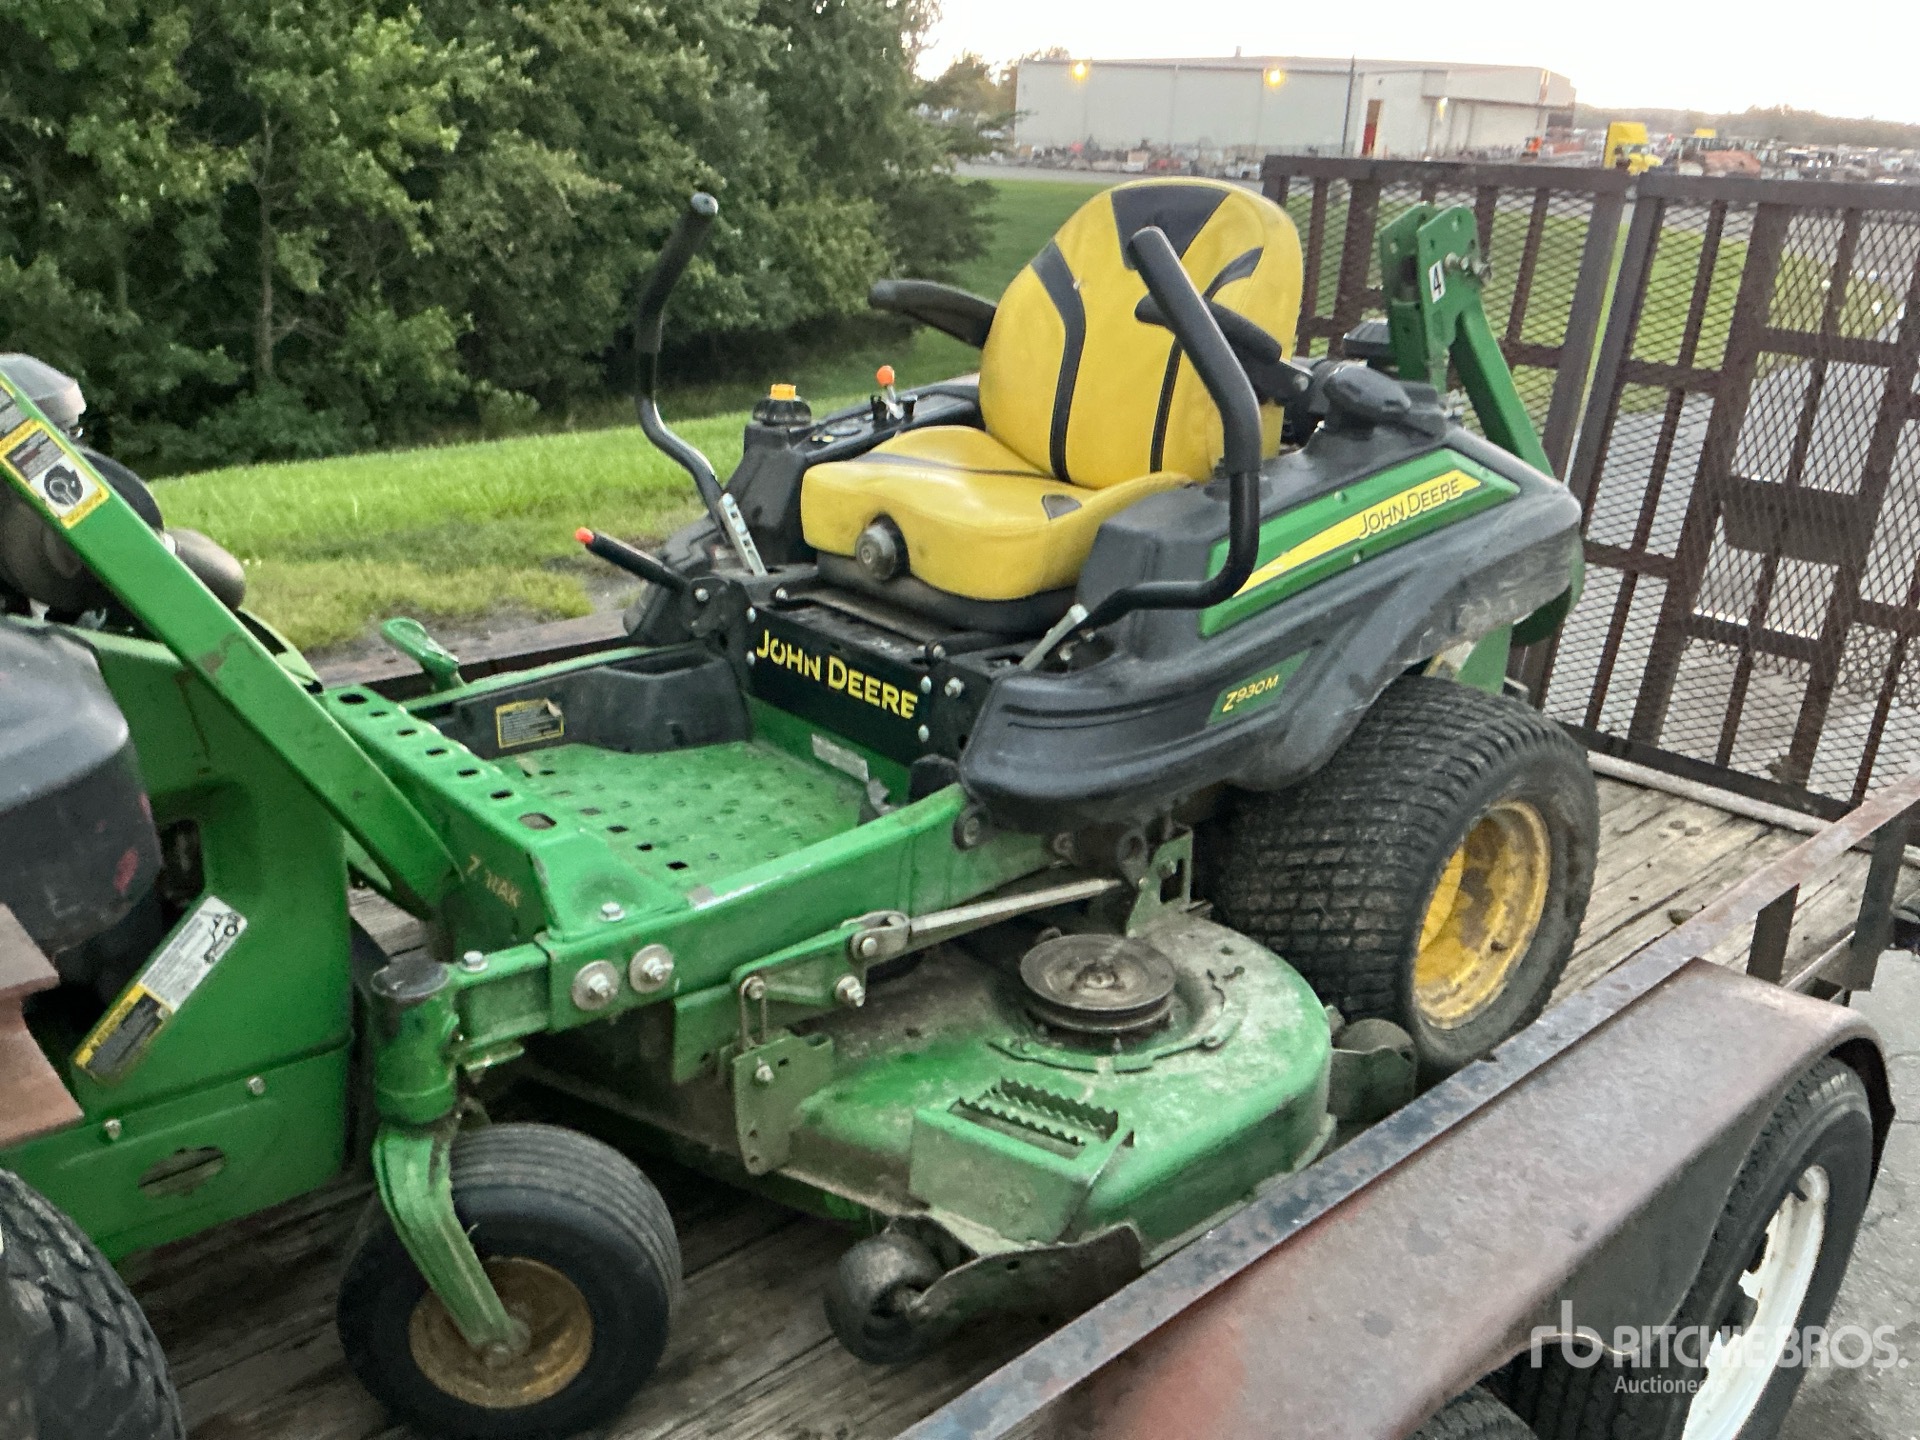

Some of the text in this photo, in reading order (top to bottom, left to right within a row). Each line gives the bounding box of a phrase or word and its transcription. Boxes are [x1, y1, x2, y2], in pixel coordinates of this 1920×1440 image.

[1433, 265, 1442, 296] 4
[1359, 478, 1461, 537] JOHN DEERE
[756, 628, 919, 720] JOHN DEERE
[1222, 674, 1279, 713] Z930M
